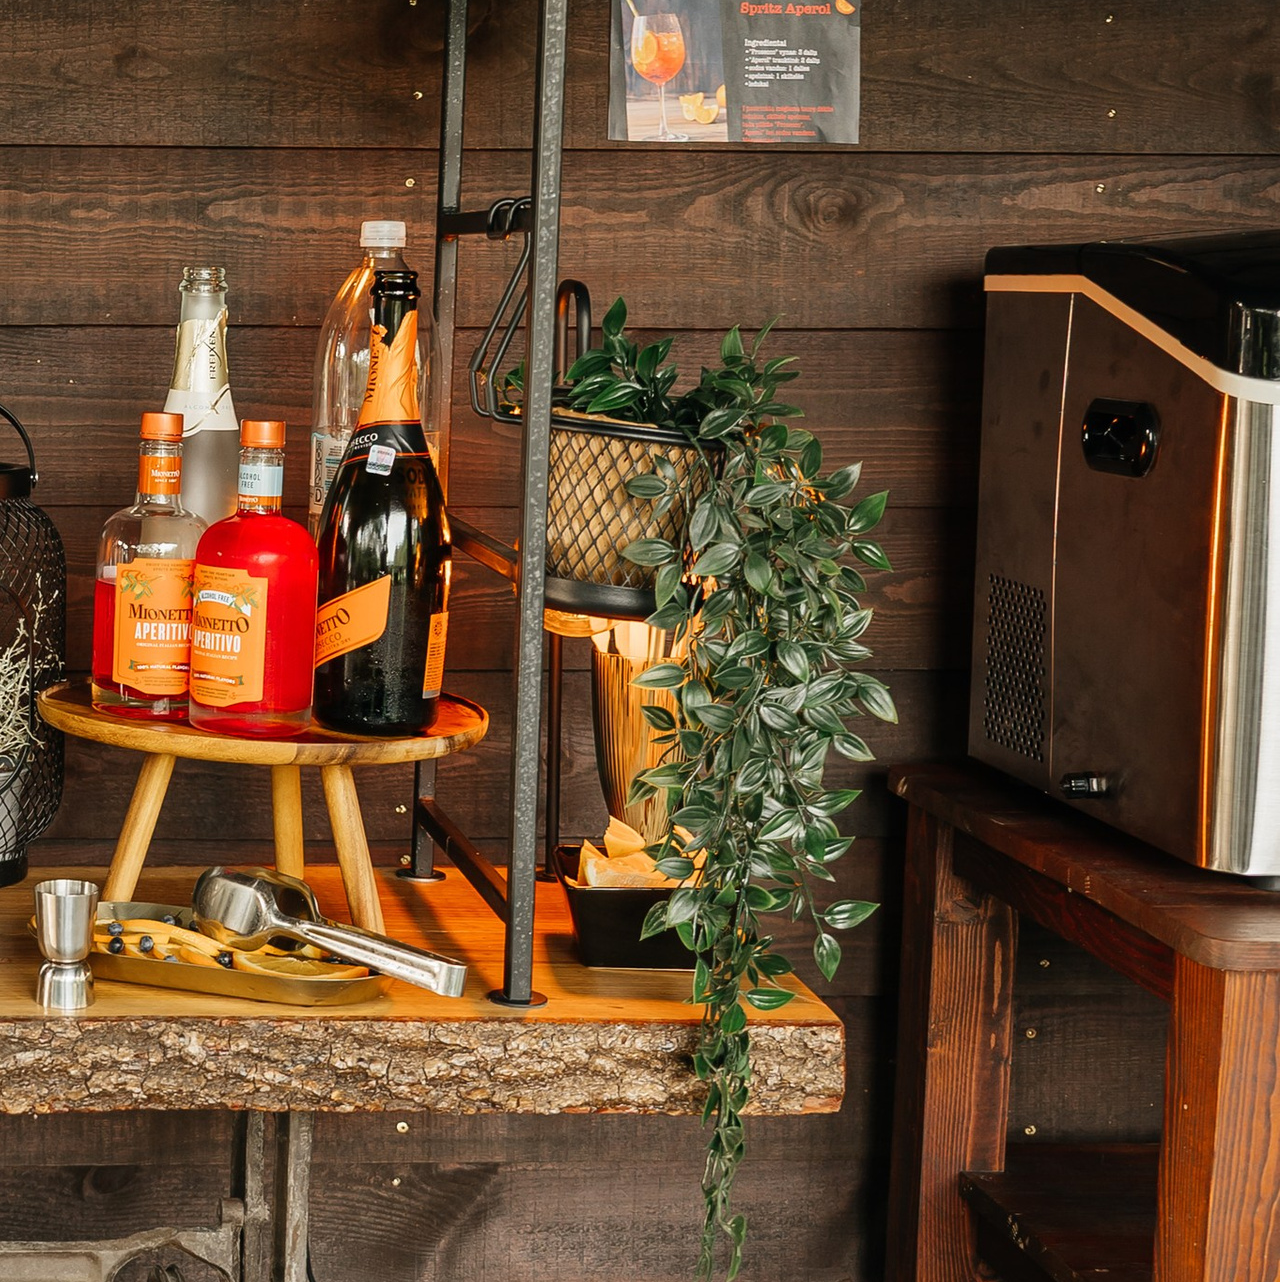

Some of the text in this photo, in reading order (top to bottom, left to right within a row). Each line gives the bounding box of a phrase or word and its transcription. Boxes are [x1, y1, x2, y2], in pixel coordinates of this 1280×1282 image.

[740, 2, 832, 16] Spritz Aperol
[209, 326, 218, 381] FREIXEN
[241, 480, 254, 489] FREE
[218, 594, 230, 604] FREE
[128, 603, 193, 621] MIONETT
[315, 608, 351, 639] NETTO
